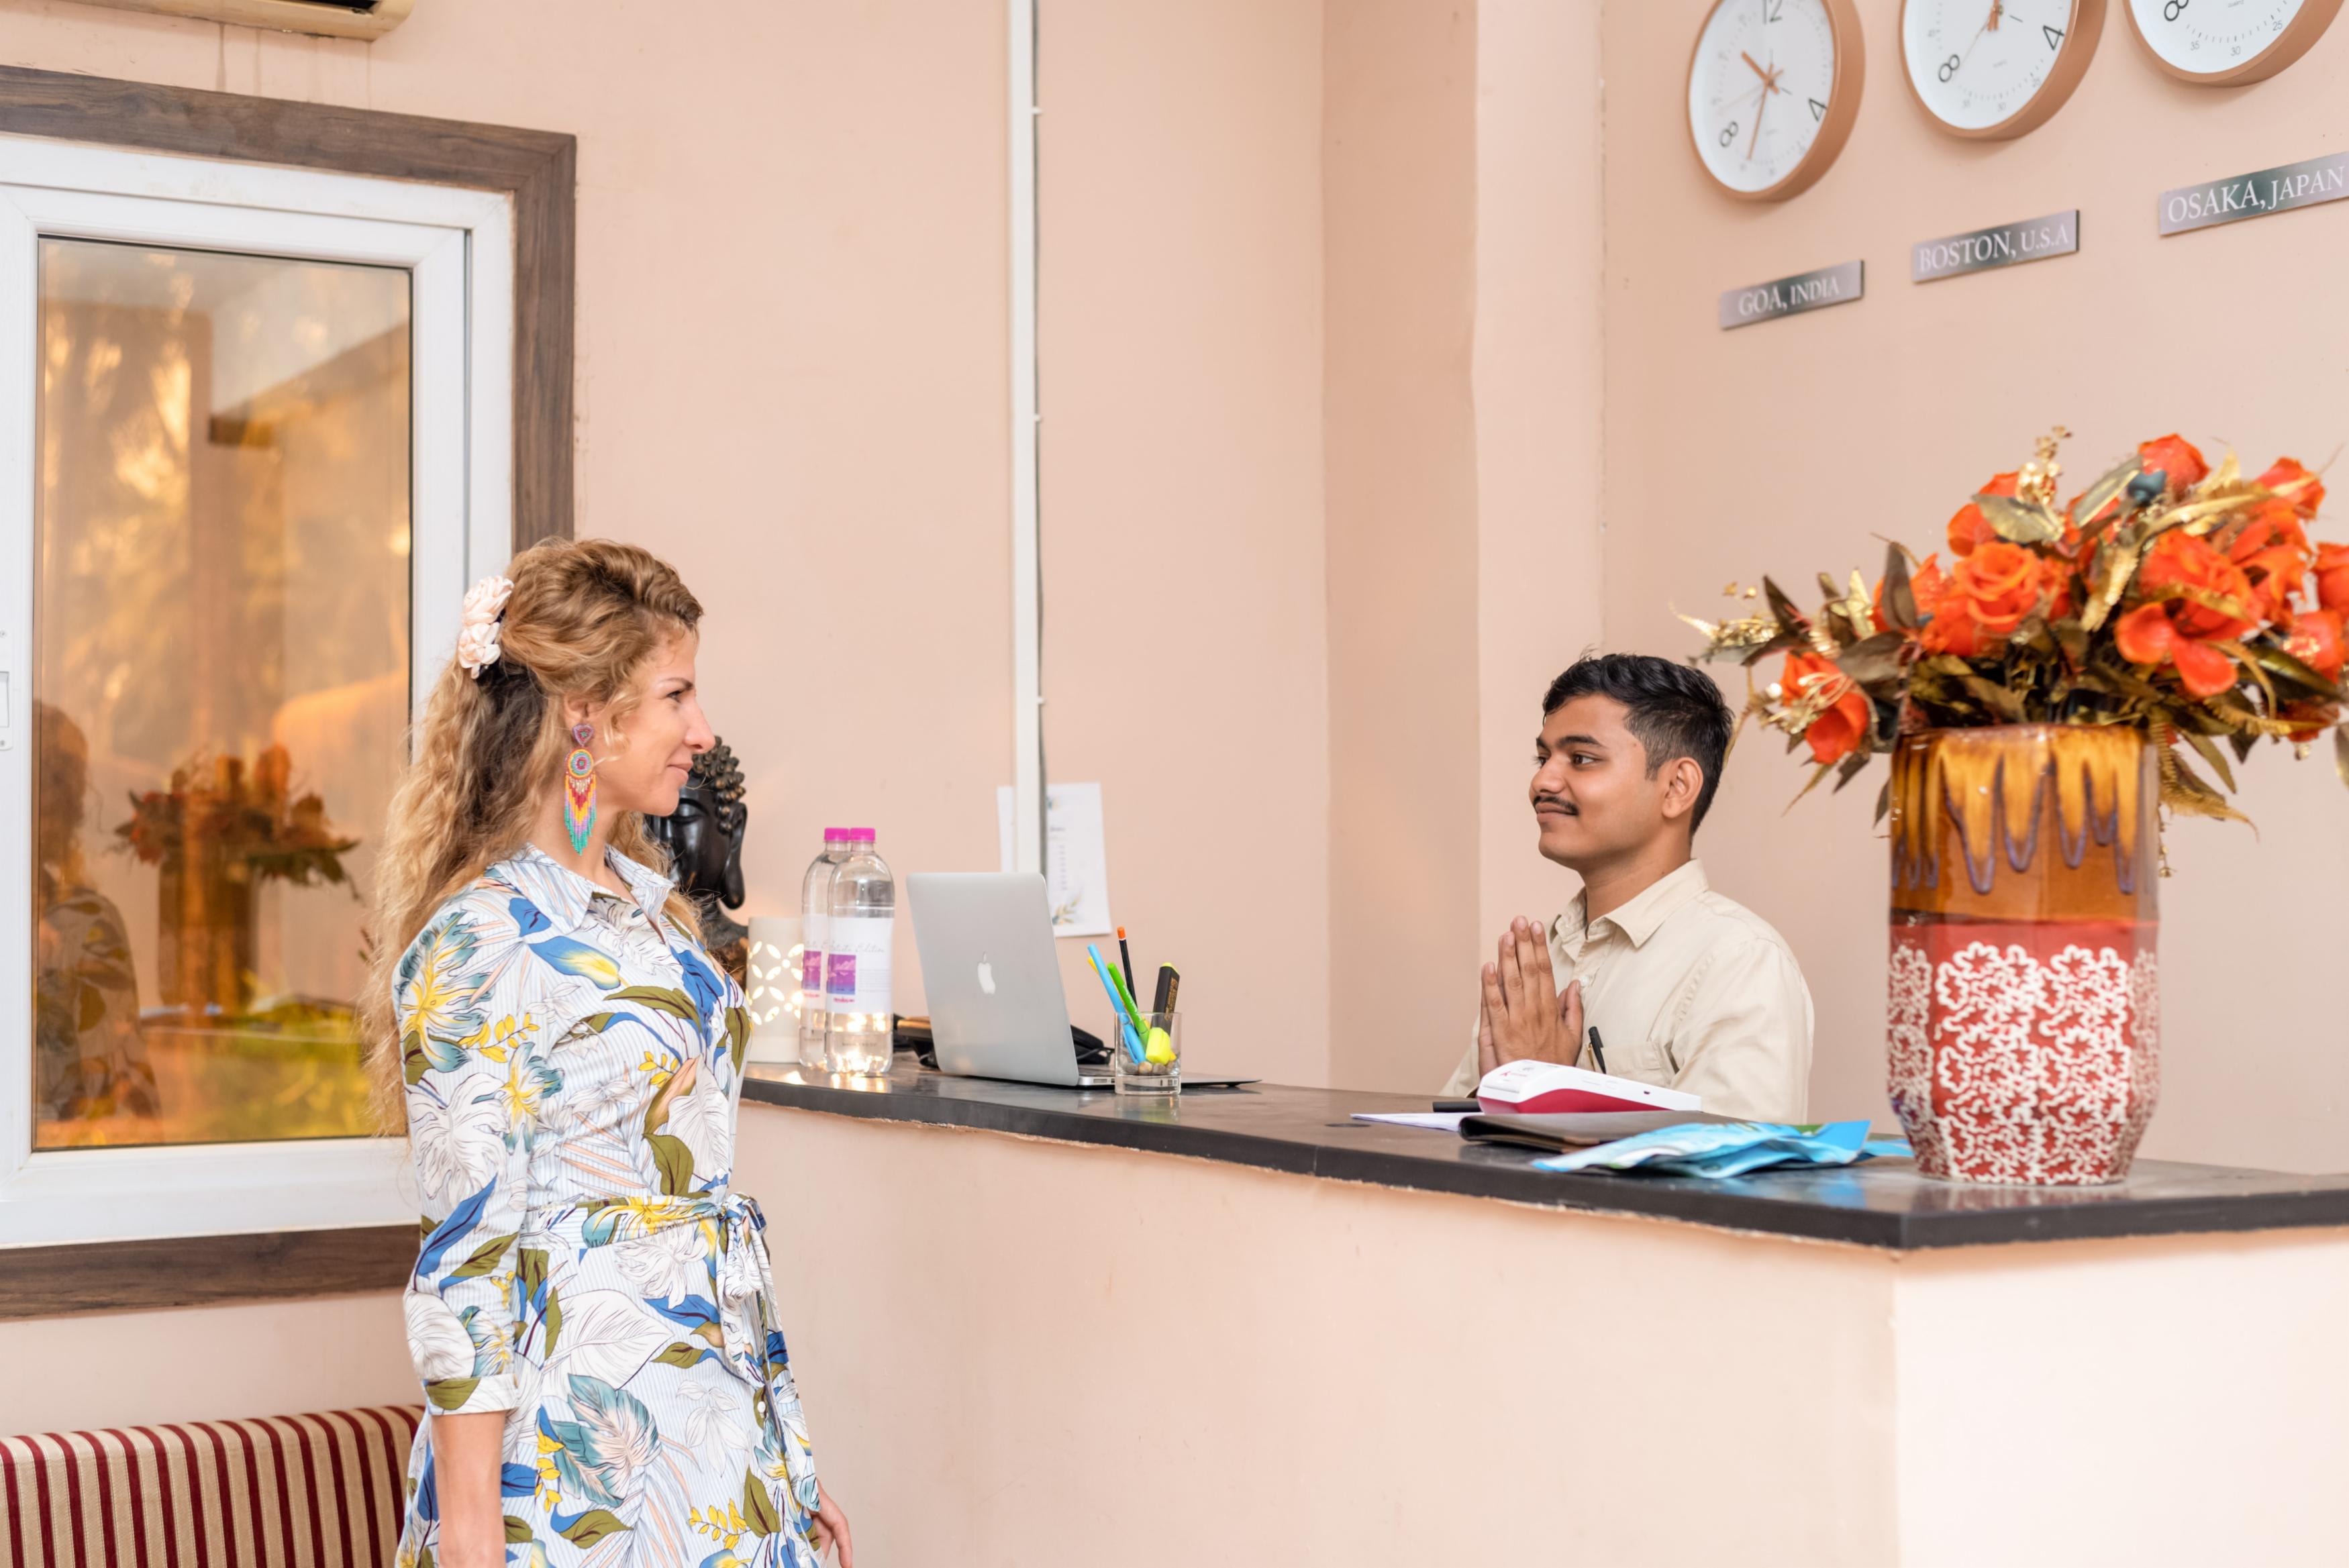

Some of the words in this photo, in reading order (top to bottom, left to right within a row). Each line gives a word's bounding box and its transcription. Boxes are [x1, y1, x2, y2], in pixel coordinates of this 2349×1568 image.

[1763, 0, 1783, 24] 12
[2164, 0, 2189, 21] 8
[2272, 19, 2283, 31] 25
[2043, 25, 2064, 50] 4
[2190, 40, 2200, 50] 35
[2230, 46, 2241, 56] 30
[1938, 54, 1960, 83] 8
[1808, 98, 1827, 122] 4
[1719, 121, 1739, 148] 8
[2168, 180, 2266, 223] OSAKA,
[2268, 166, 2345, 210] JAPAN
[1919, 231, 2016, 272] BOSTON,
[2021, 223, 2069, 252] U.S.A
[1738, 286, 1787, 316] GOA,
[1790, 276, 1840, 305] INDIA
